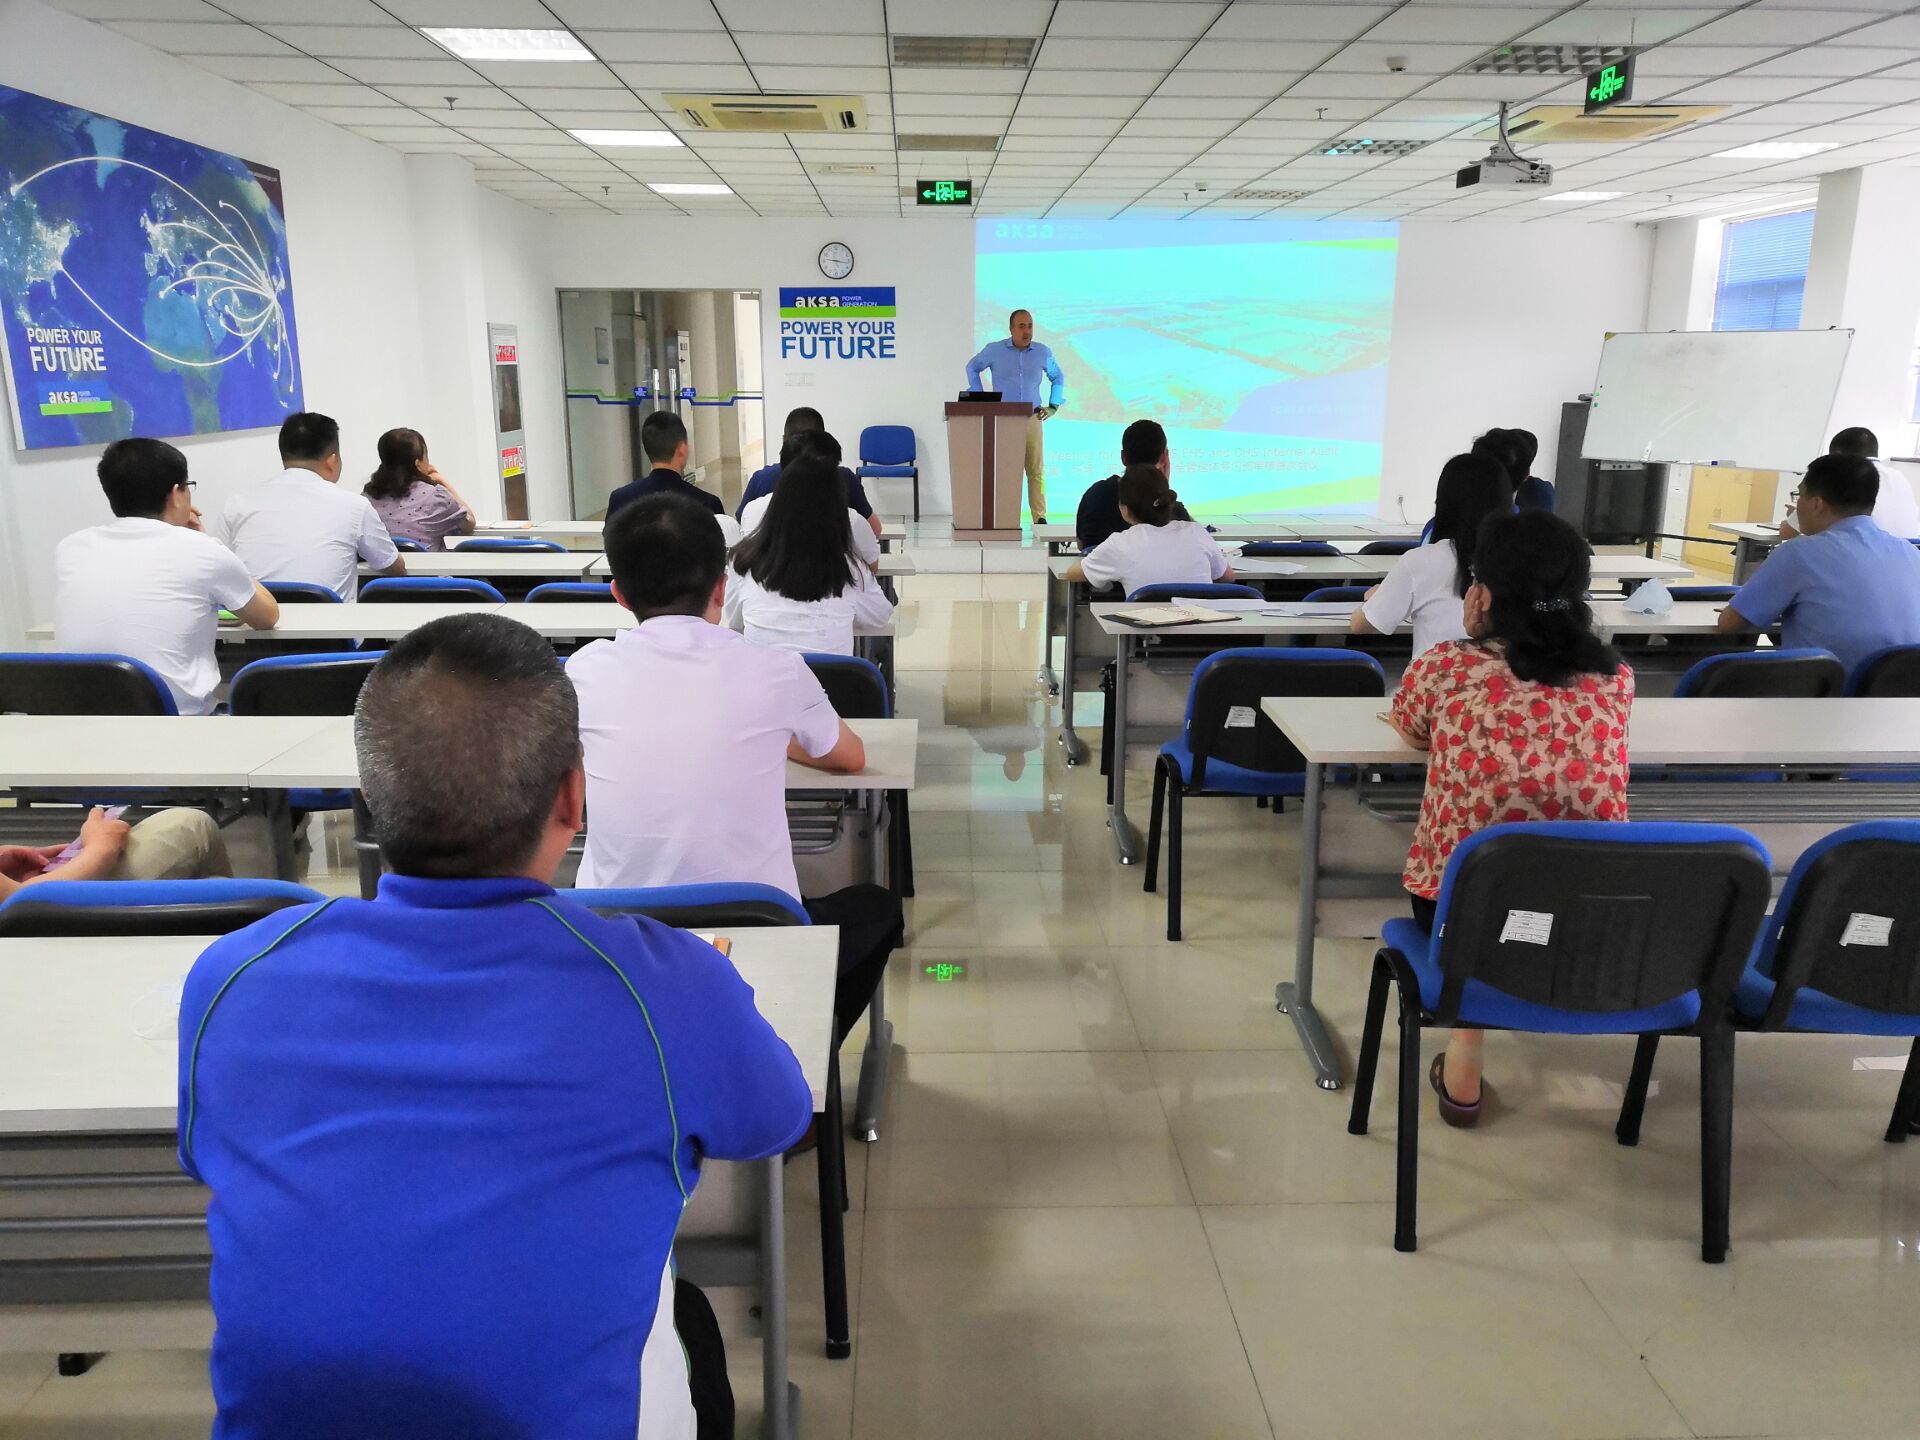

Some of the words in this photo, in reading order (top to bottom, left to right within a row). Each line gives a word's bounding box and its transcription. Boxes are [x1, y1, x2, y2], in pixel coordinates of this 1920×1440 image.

[995, 223, 1054, 239] aksa
[795, 296, 840, 308] aksa
[780, 321, 843, 335] POWER
[847, 321, 896, 335] YOUR
[27, 328, 70, 344] POWER
[71, 329, 103, 345] YOUR
[781, 336, 896, 359] FUTURE
[29, 346, 107, 372] FUTURE
[48, 391, 78, 404] aksa
